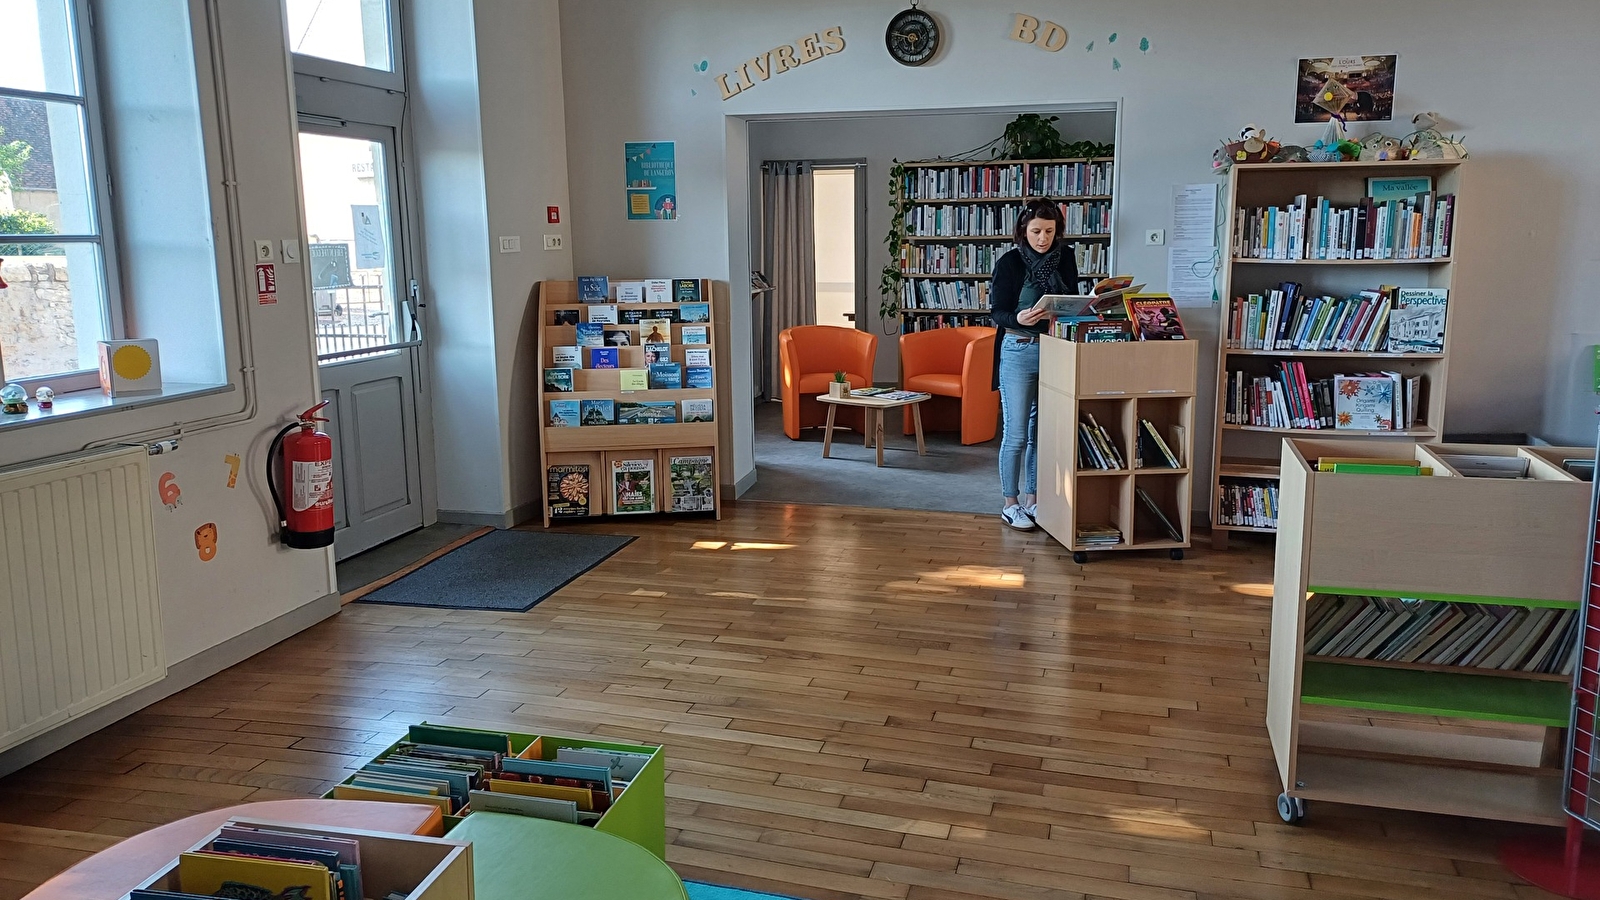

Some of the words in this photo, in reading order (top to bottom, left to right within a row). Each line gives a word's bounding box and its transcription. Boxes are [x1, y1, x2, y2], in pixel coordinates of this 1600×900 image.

[1008, 13, 1068, 52] BD
[714, 26, 846, 101] LIVRES
[1396, 183, 1418, 191] vallée
[1401, 295, 1447, 308] Perspective
[158, 471, 181, 507] 6
[224, 454, 241, 489] 7
[194, 522, 218, 562] 8
